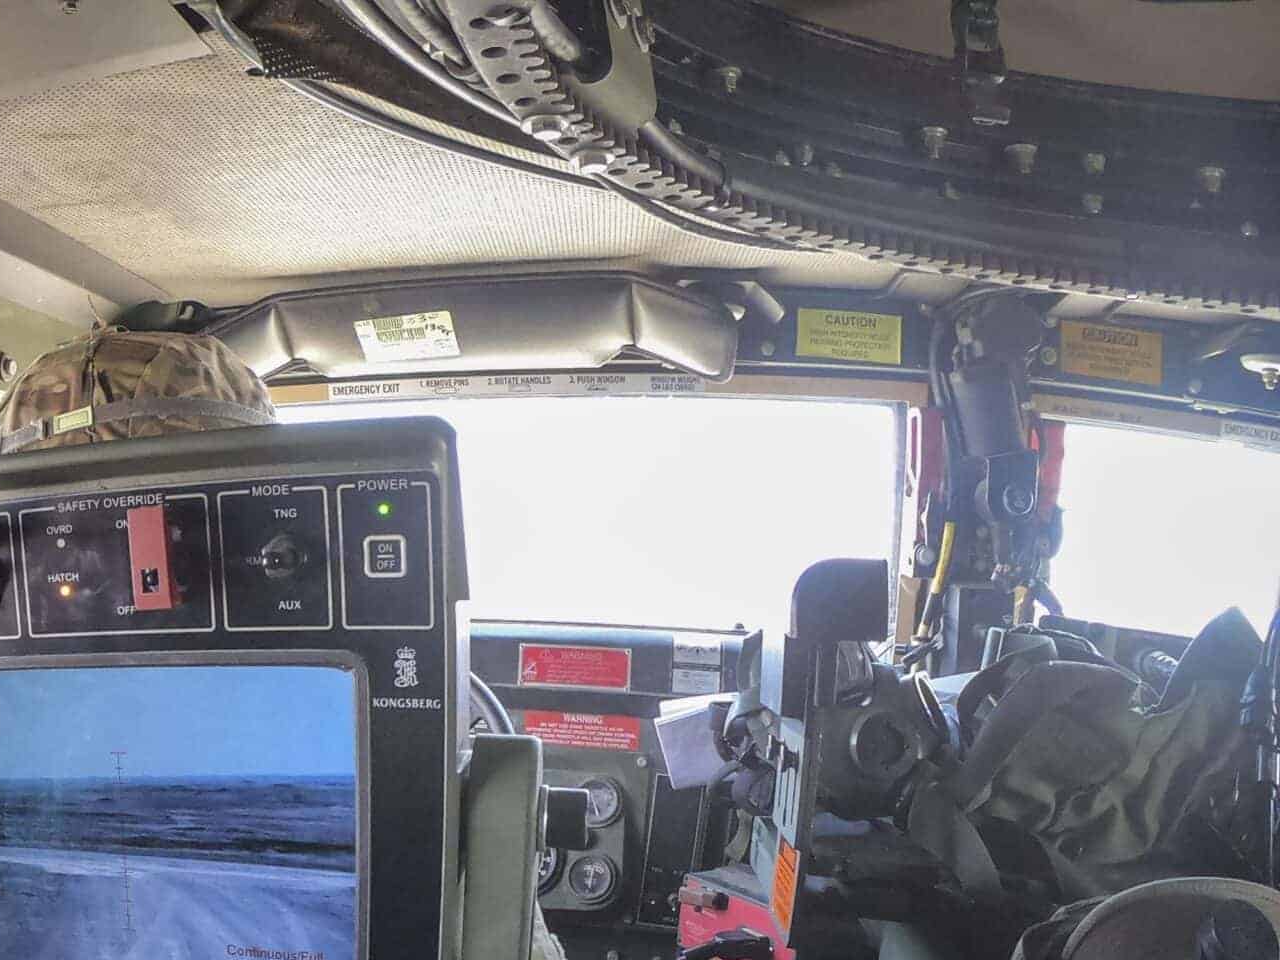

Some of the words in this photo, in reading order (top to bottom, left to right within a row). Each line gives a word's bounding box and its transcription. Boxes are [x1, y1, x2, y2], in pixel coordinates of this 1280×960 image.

[825, 315, 877, 328] CAUTION
[332, 384, 380, 396] EMERGENCY
[383, 383, 400, 394] EXIT
[252, 484, 290, 497] MODE
[357, 479, 408, 491] POWER
[57, 500, 100, 513] SAFETY
[103, 493, 164, 508] OVERRIDE
[274, 508, 297, 518] TNG
[46, 525, 73, 536] OVRD
[378, 543, 392, 553] ON
[376, 560, 396, 571] OFF
[47, 572, 80, 583] HATCH
[278, 600, 301, 611] AUX
[372, 697, 441, 709] KONGSBERG
